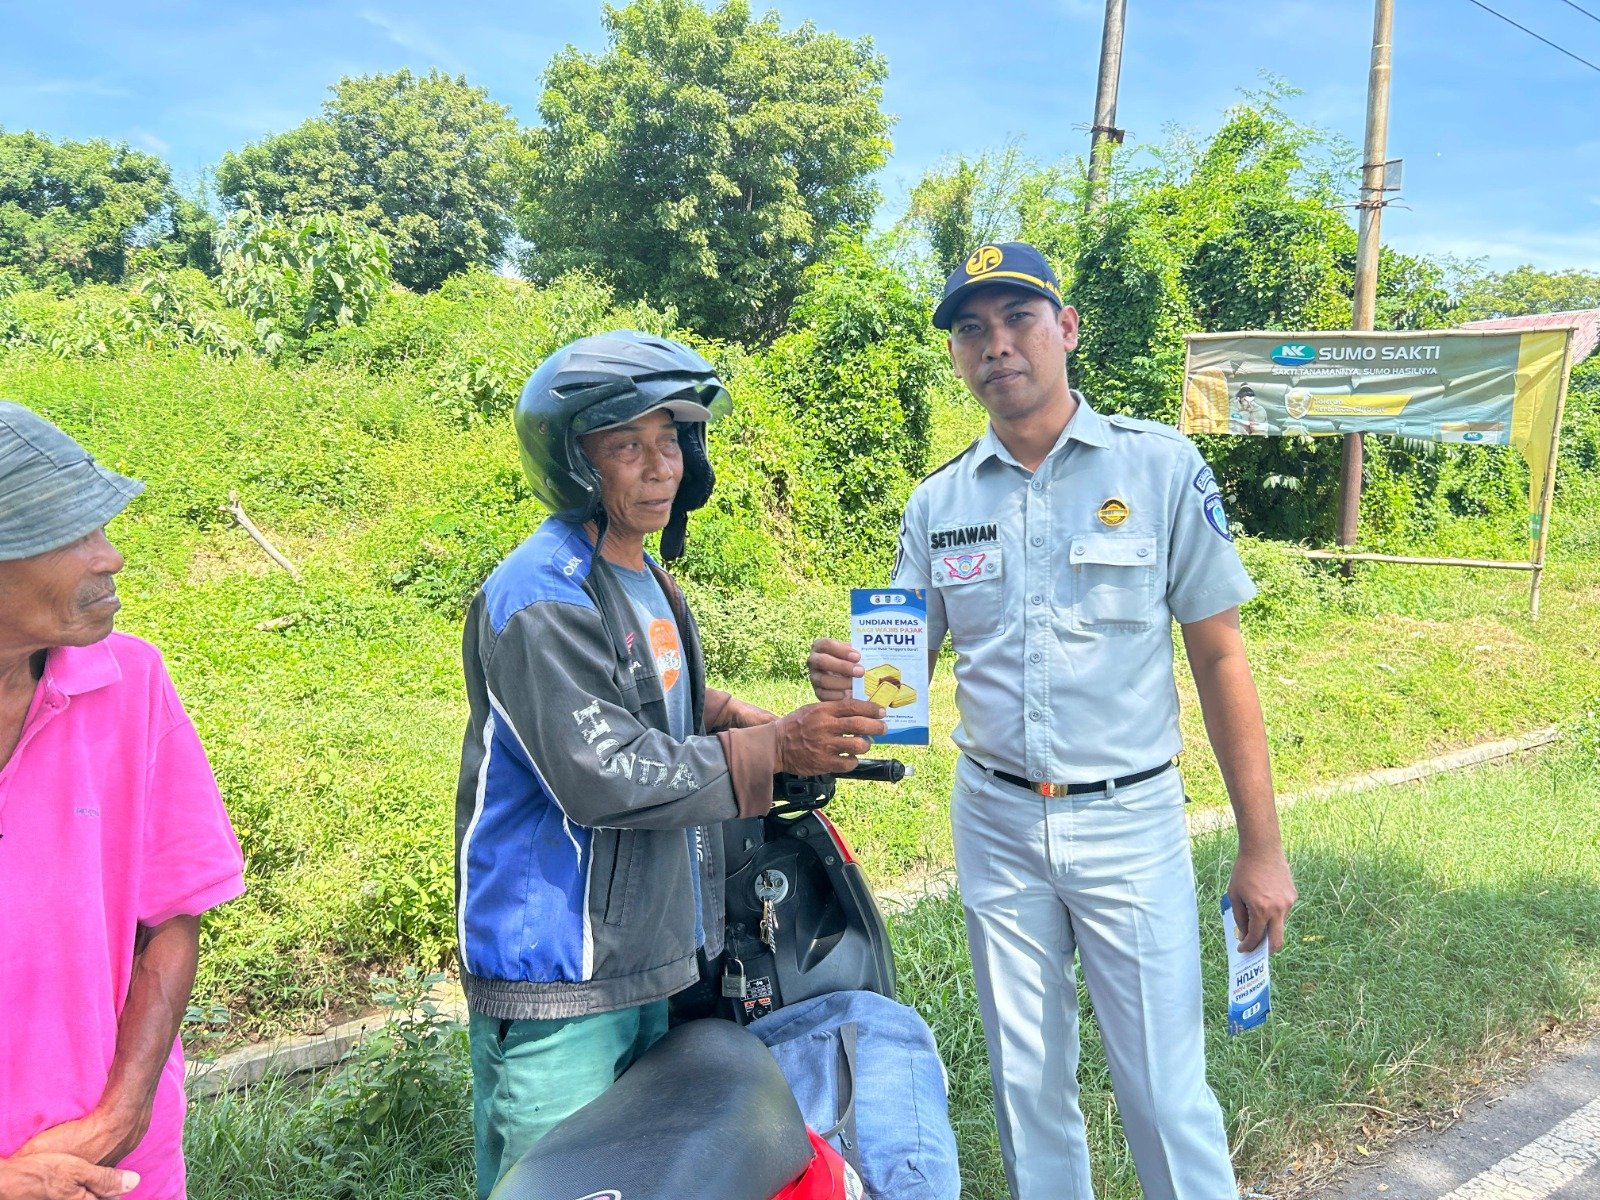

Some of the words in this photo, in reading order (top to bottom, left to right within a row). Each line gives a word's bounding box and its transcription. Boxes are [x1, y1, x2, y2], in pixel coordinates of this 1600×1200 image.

[1281, 345, 1306, 356] NK
[1318, 346, 1377, 361] SUMO
[1381, 345, 1441, 360] SAKTI
[1271, 367, 1297, 376] SAKTI
[1362, 367, 1391, 375] SUMO
[1392, 367, 1438, 375] HASILNYA
[930, 524, 998, 550] SETIAWAN
[863, 634, 915, 645] PATUH
[572, 699, 701, 791] HONDA
[1236, 963, 1264, 987] PATUH
